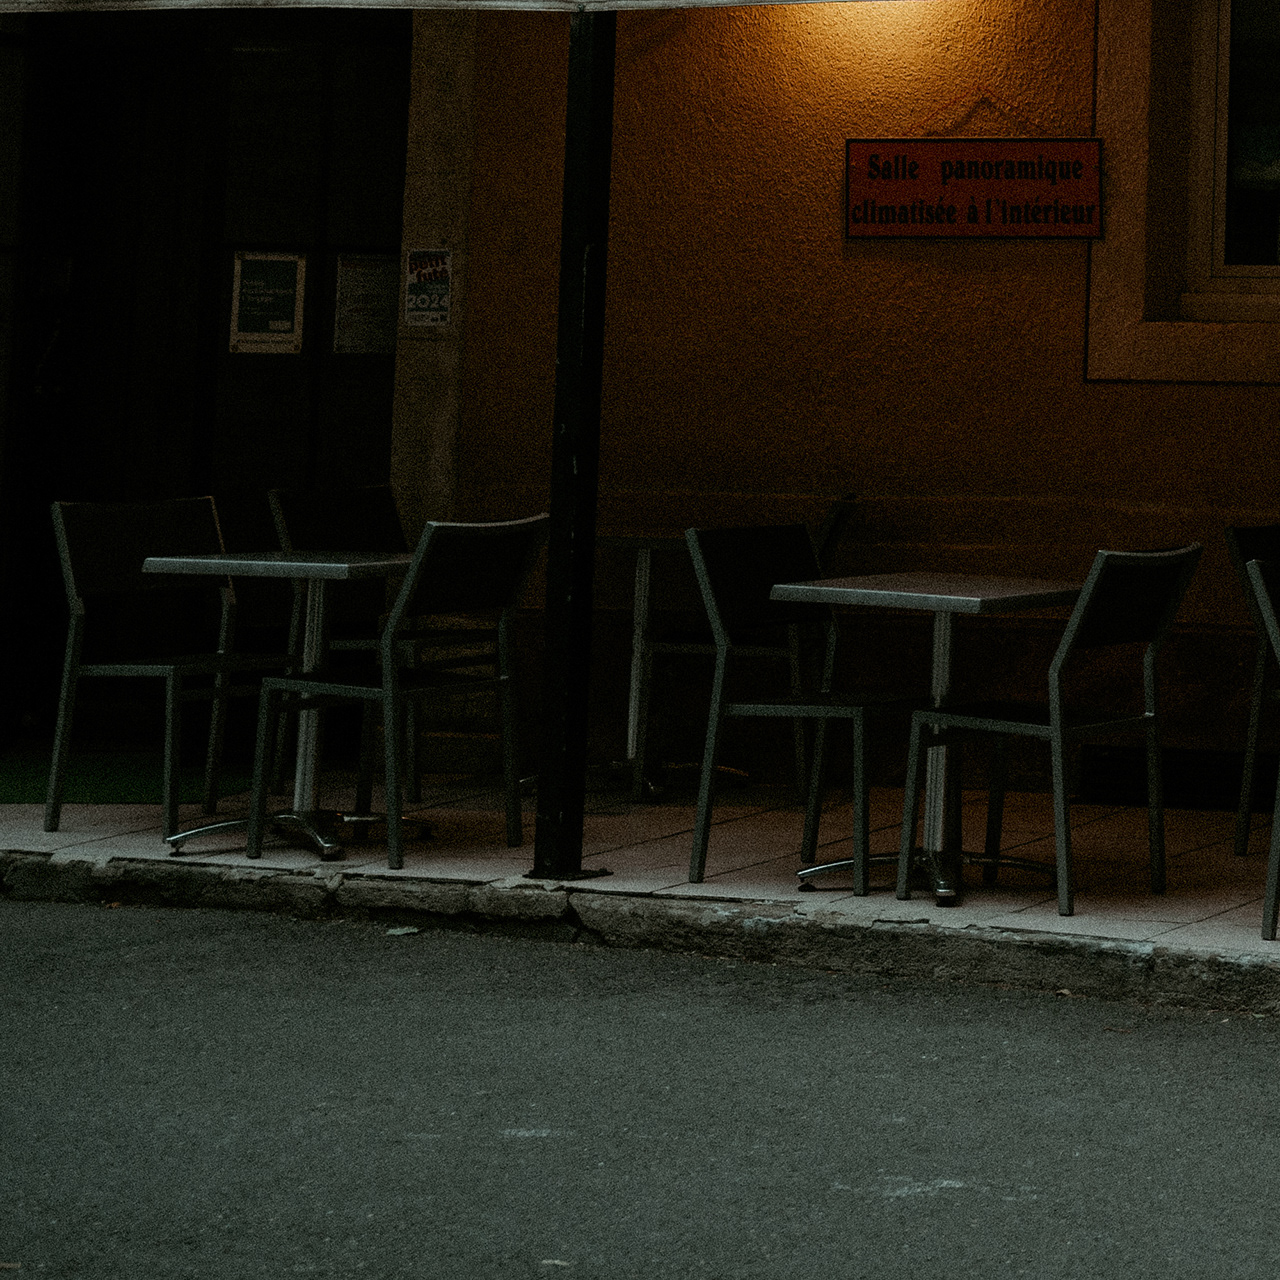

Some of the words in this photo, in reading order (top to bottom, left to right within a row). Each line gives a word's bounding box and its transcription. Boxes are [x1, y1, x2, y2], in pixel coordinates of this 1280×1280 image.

[868, 153, 919, 180] Salle
[941, 155, 1083, 185] panoramique
[852, 196, 957, 224] climatisée
[967, 196, 978, 224] à
[985, 196, 1096, 224] l'intérieur
[408, 294, 450, 309] 2024
